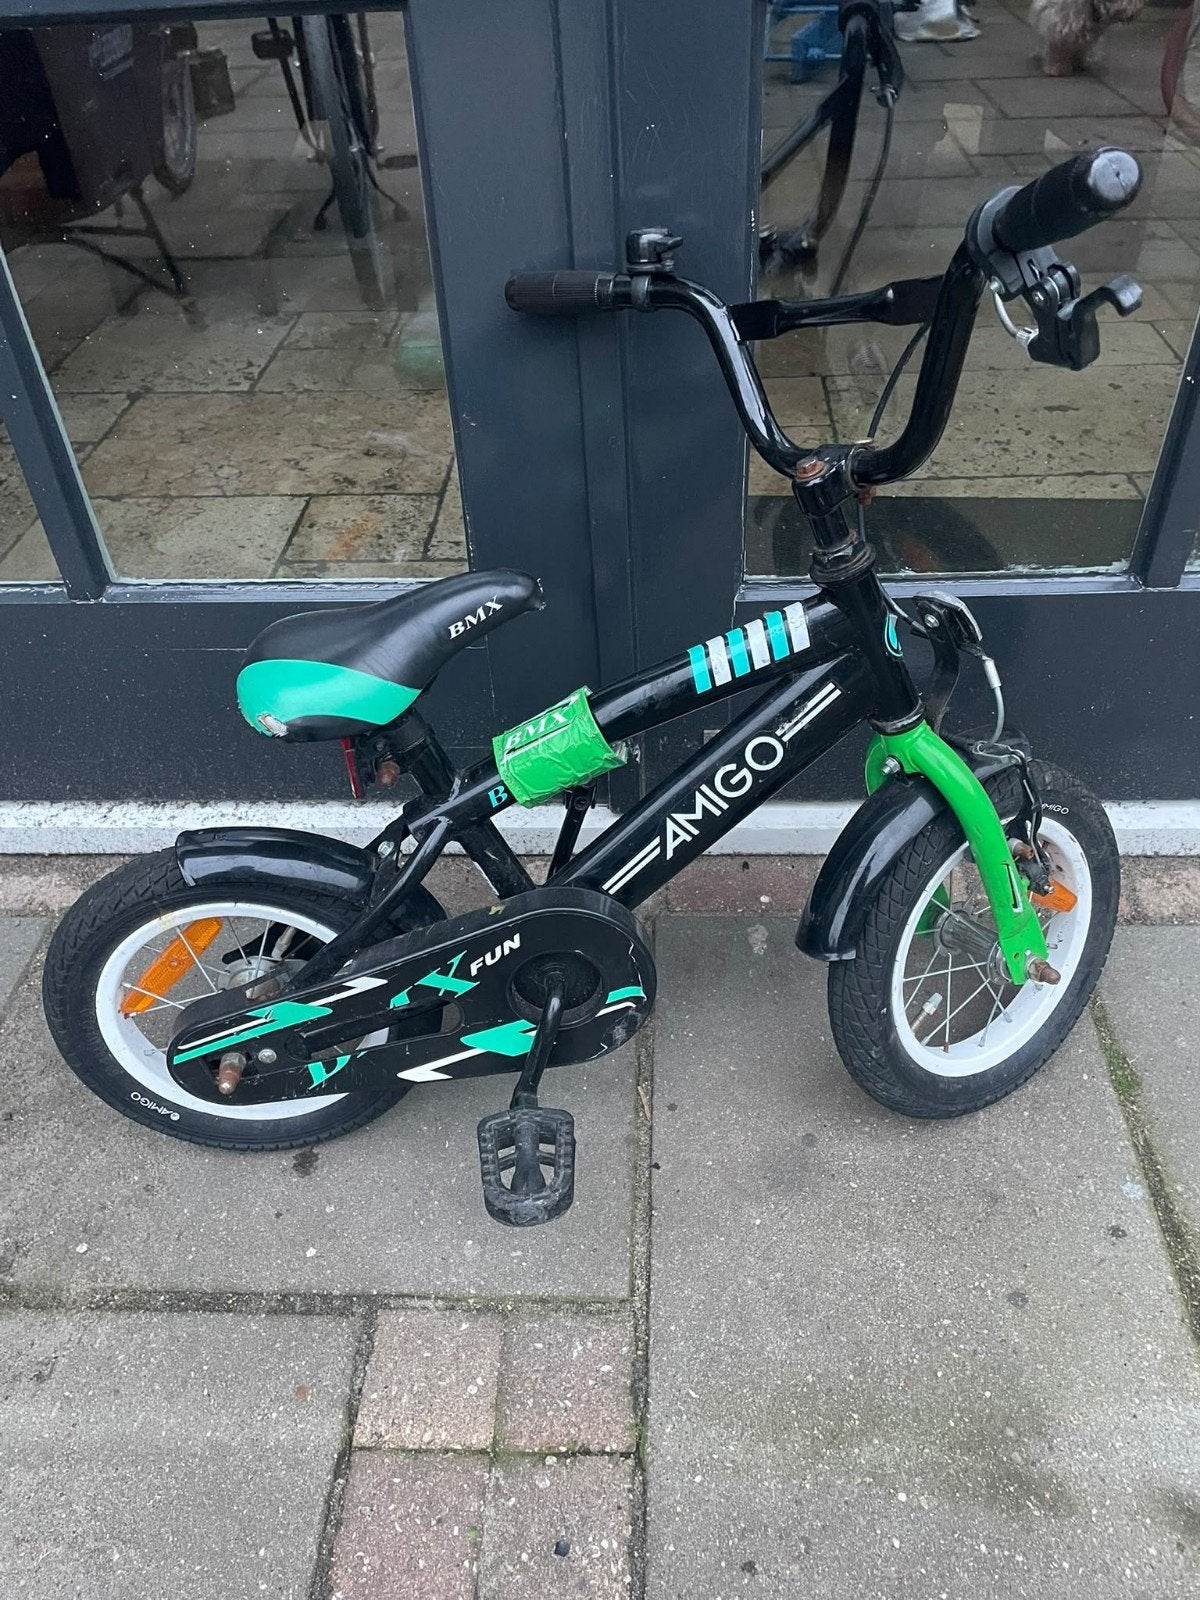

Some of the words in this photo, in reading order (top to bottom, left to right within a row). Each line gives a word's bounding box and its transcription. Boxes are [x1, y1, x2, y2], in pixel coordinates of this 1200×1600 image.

[448, 594, 503, 640] BMX
[503, 705, 568, 752] BMX
[666, 736, 784, 860] AMIGO
[470, 933, 520, 977] FUN
[131, 1092, 173, 1115] AMIGO
